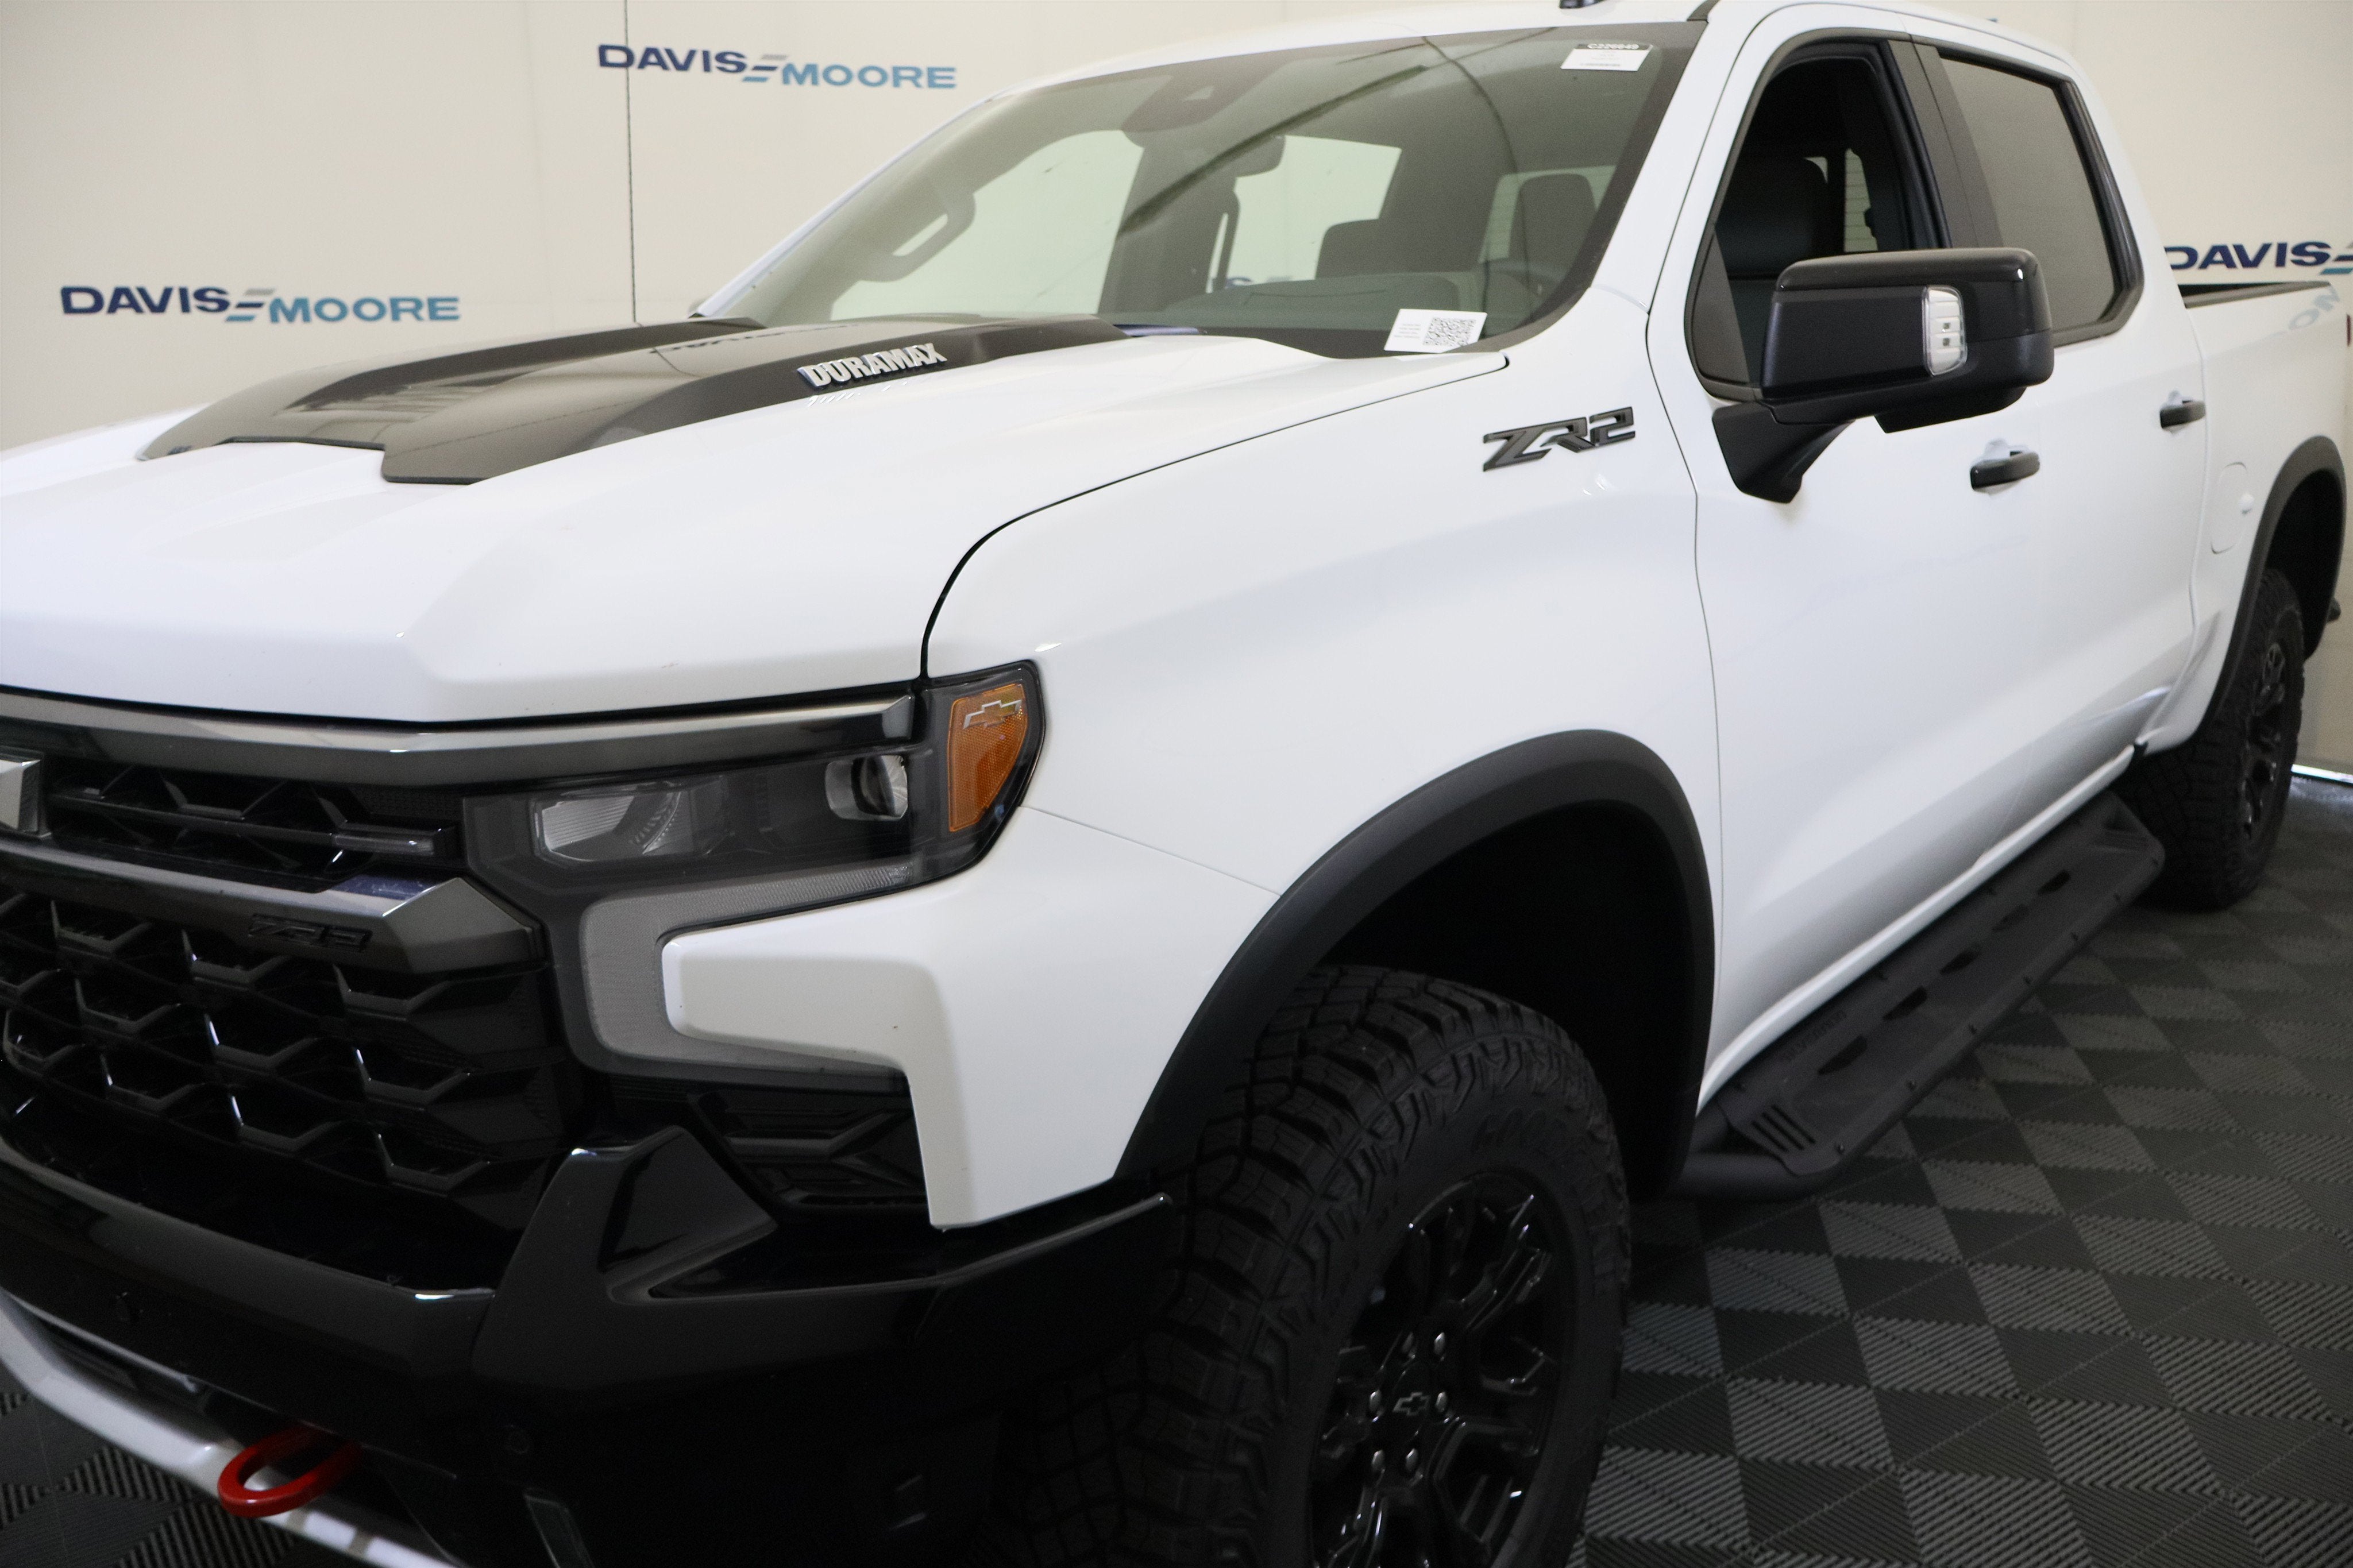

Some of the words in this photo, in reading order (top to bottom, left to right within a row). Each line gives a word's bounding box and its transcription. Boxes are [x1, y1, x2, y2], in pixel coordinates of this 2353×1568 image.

[598, 44, 748, 74] DAVIS
[782, 63, 956, 89] MOORE
[2163, 241, 2332, 271] DAVIS
[60, 285, 232, 315] DAVIS
[268, 296, 461, 324] MOORE
[796, 342, 948, 387] DURAMAX
[1483, 405, 1636, 472] ZR2
